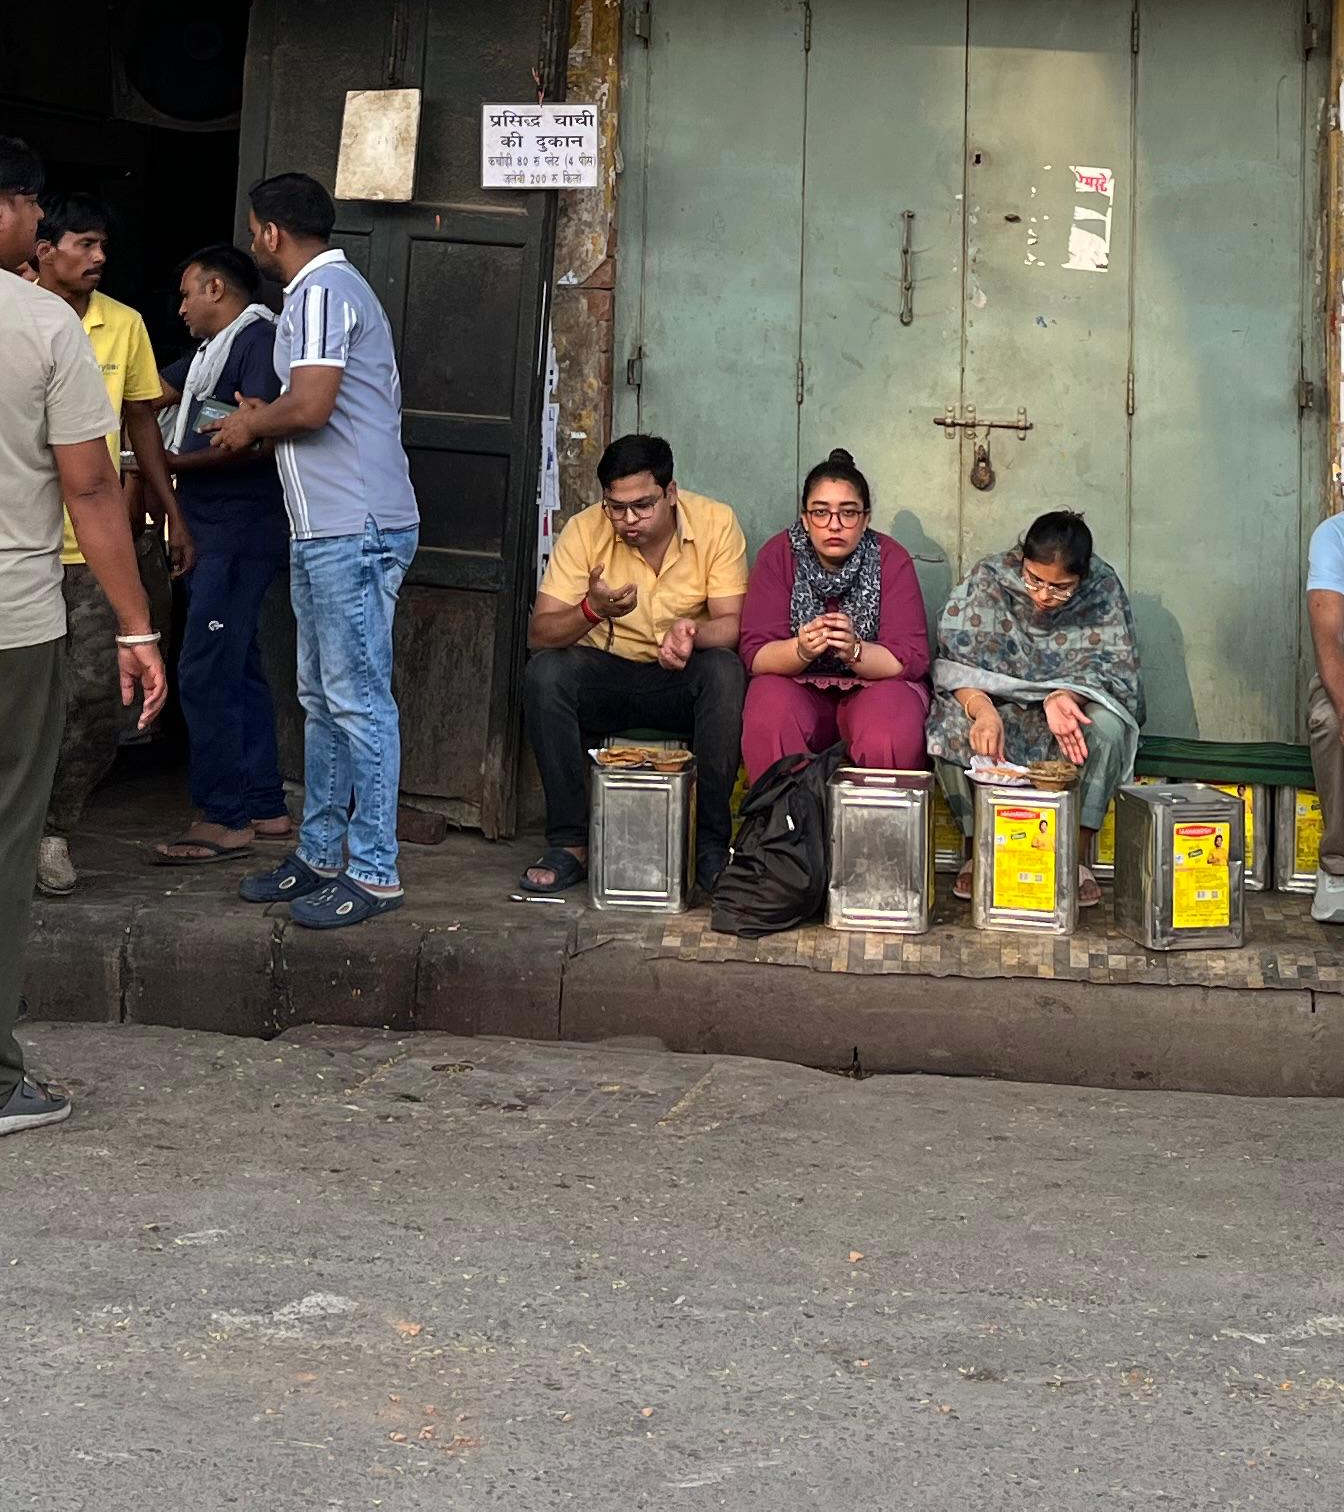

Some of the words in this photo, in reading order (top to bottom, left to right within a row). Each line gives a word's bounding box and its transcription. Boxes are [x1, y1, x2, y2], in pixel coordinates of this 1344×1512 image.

[490, 110, 542, 127] प्रसिद्ध
[553, 110, 594, 126] चाची
[500, 131, 523, 147] की
[536, 136, 584, 152] दुकान
[530, 174, 546, 184] 200
